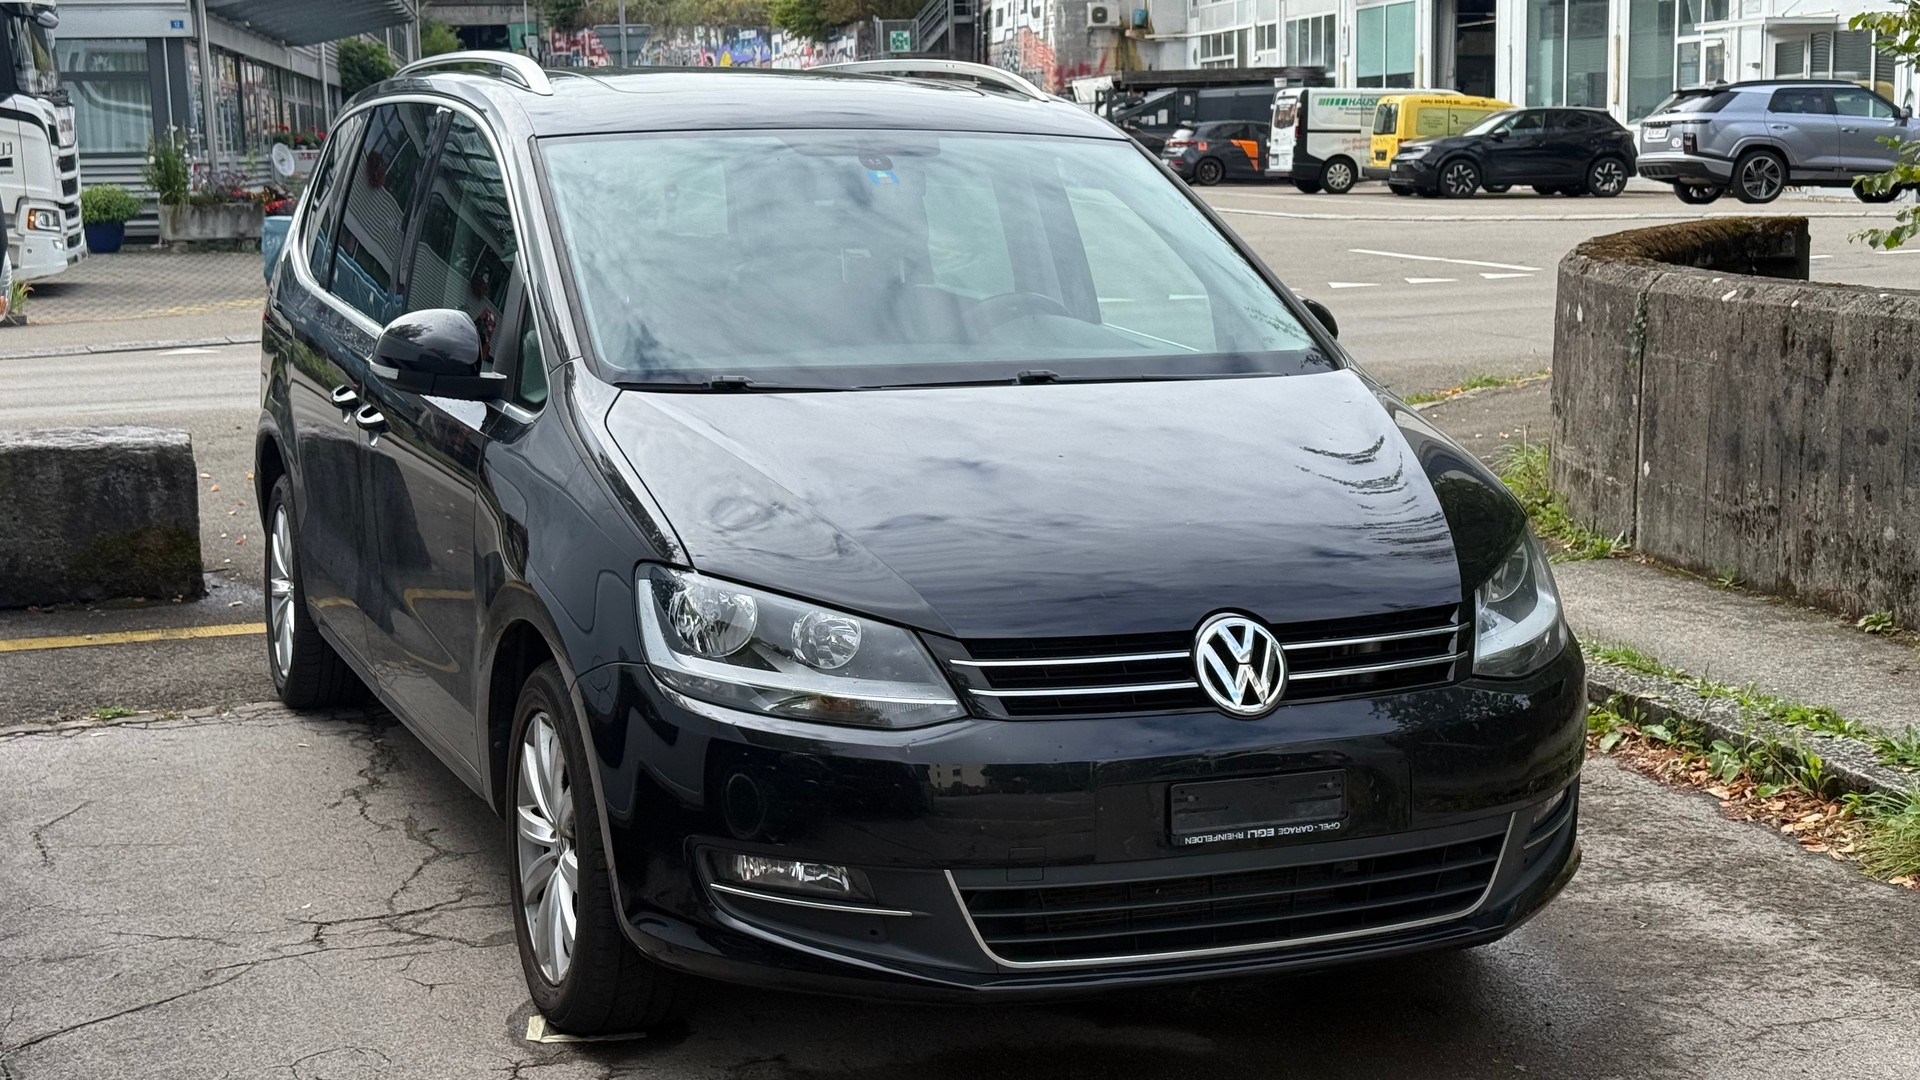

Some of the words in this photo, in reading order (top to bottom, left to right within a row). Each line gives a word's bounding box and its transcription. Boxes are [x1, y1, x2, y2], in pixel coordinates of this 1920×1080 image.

[1199, 617, 1281, 710] VW
[1184, 832, 1244, 845] RHEINFELDEN
[1247, 828, 1275, 839] EGLI
